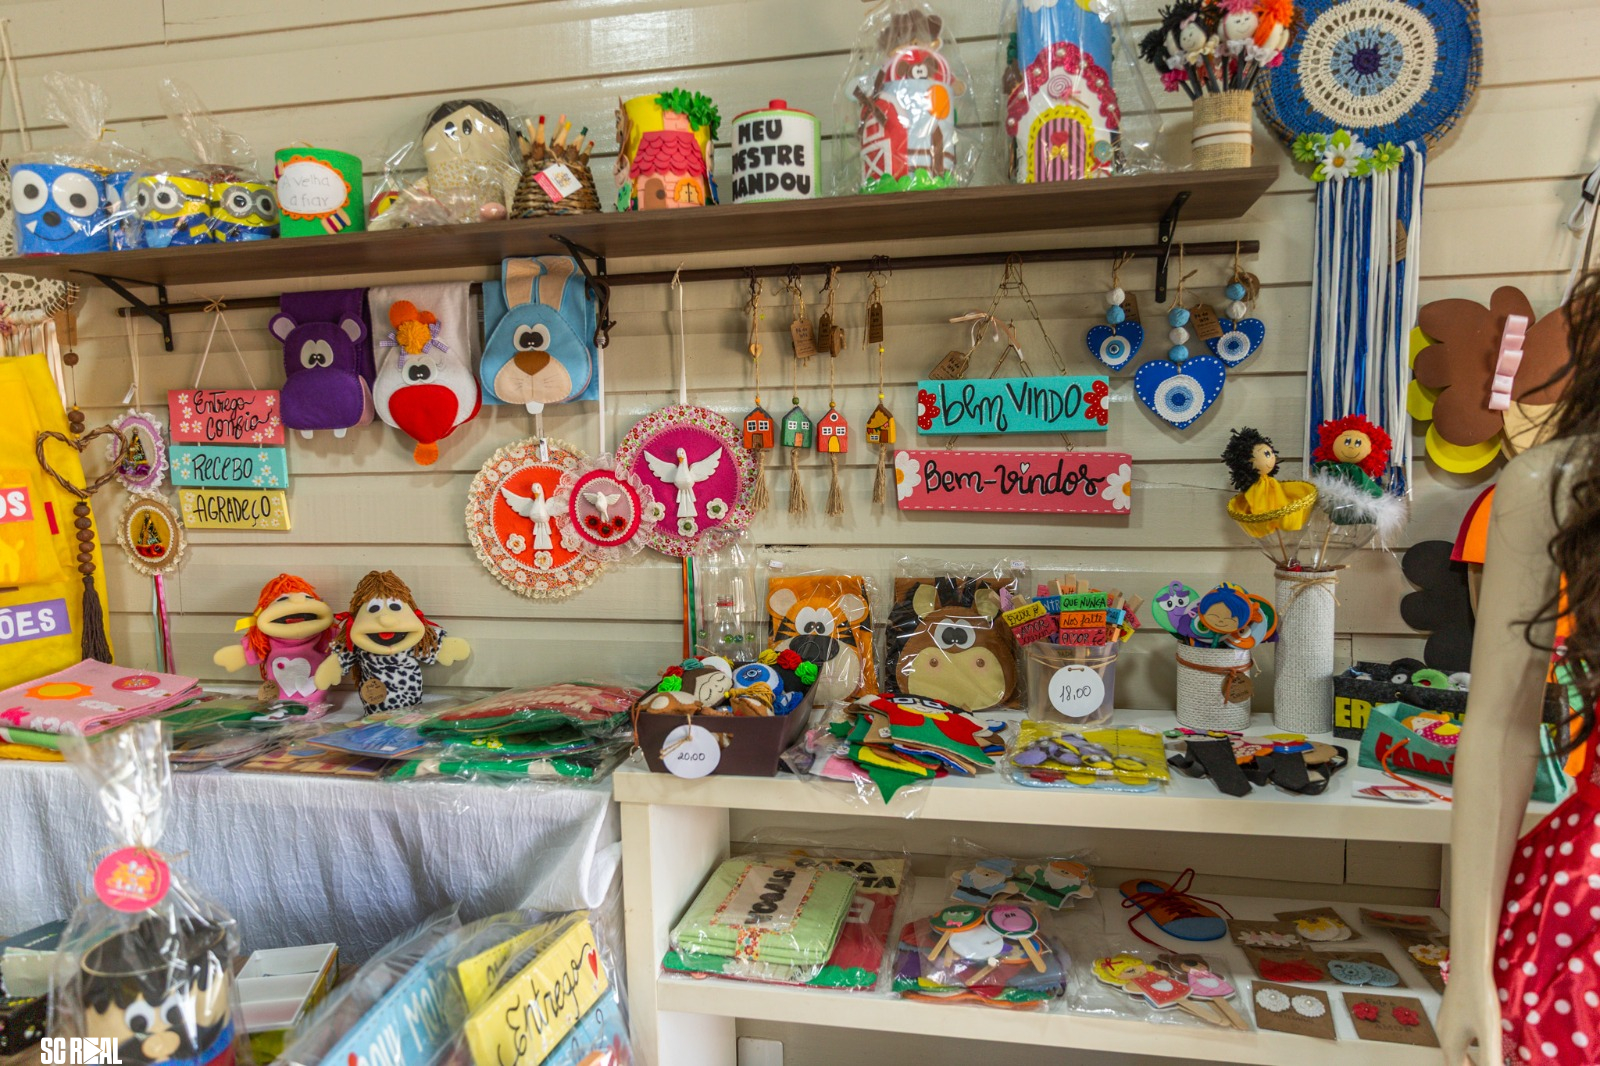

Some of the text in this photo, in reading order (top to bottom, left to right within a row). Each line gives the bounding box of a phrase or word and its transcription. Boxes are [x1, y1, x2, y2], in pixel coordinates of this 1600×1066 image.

[738, 118, 782, 145] MEU
[732, 144, 805, 175] MESTRE
[292, 174, 331, 188] velha
[732, 172, 811, 202] MANDOU
[938, 382, 1009, 432] bem
[1063, 596, 1107, 609] QUE NUNCA
[1061, 631, 1090, 644] AMOR
[1059, 685, 1092, 703] 18,00
[677, 752, 706, 761] 20,00
[497, 942, 592, 1066] Entrego
